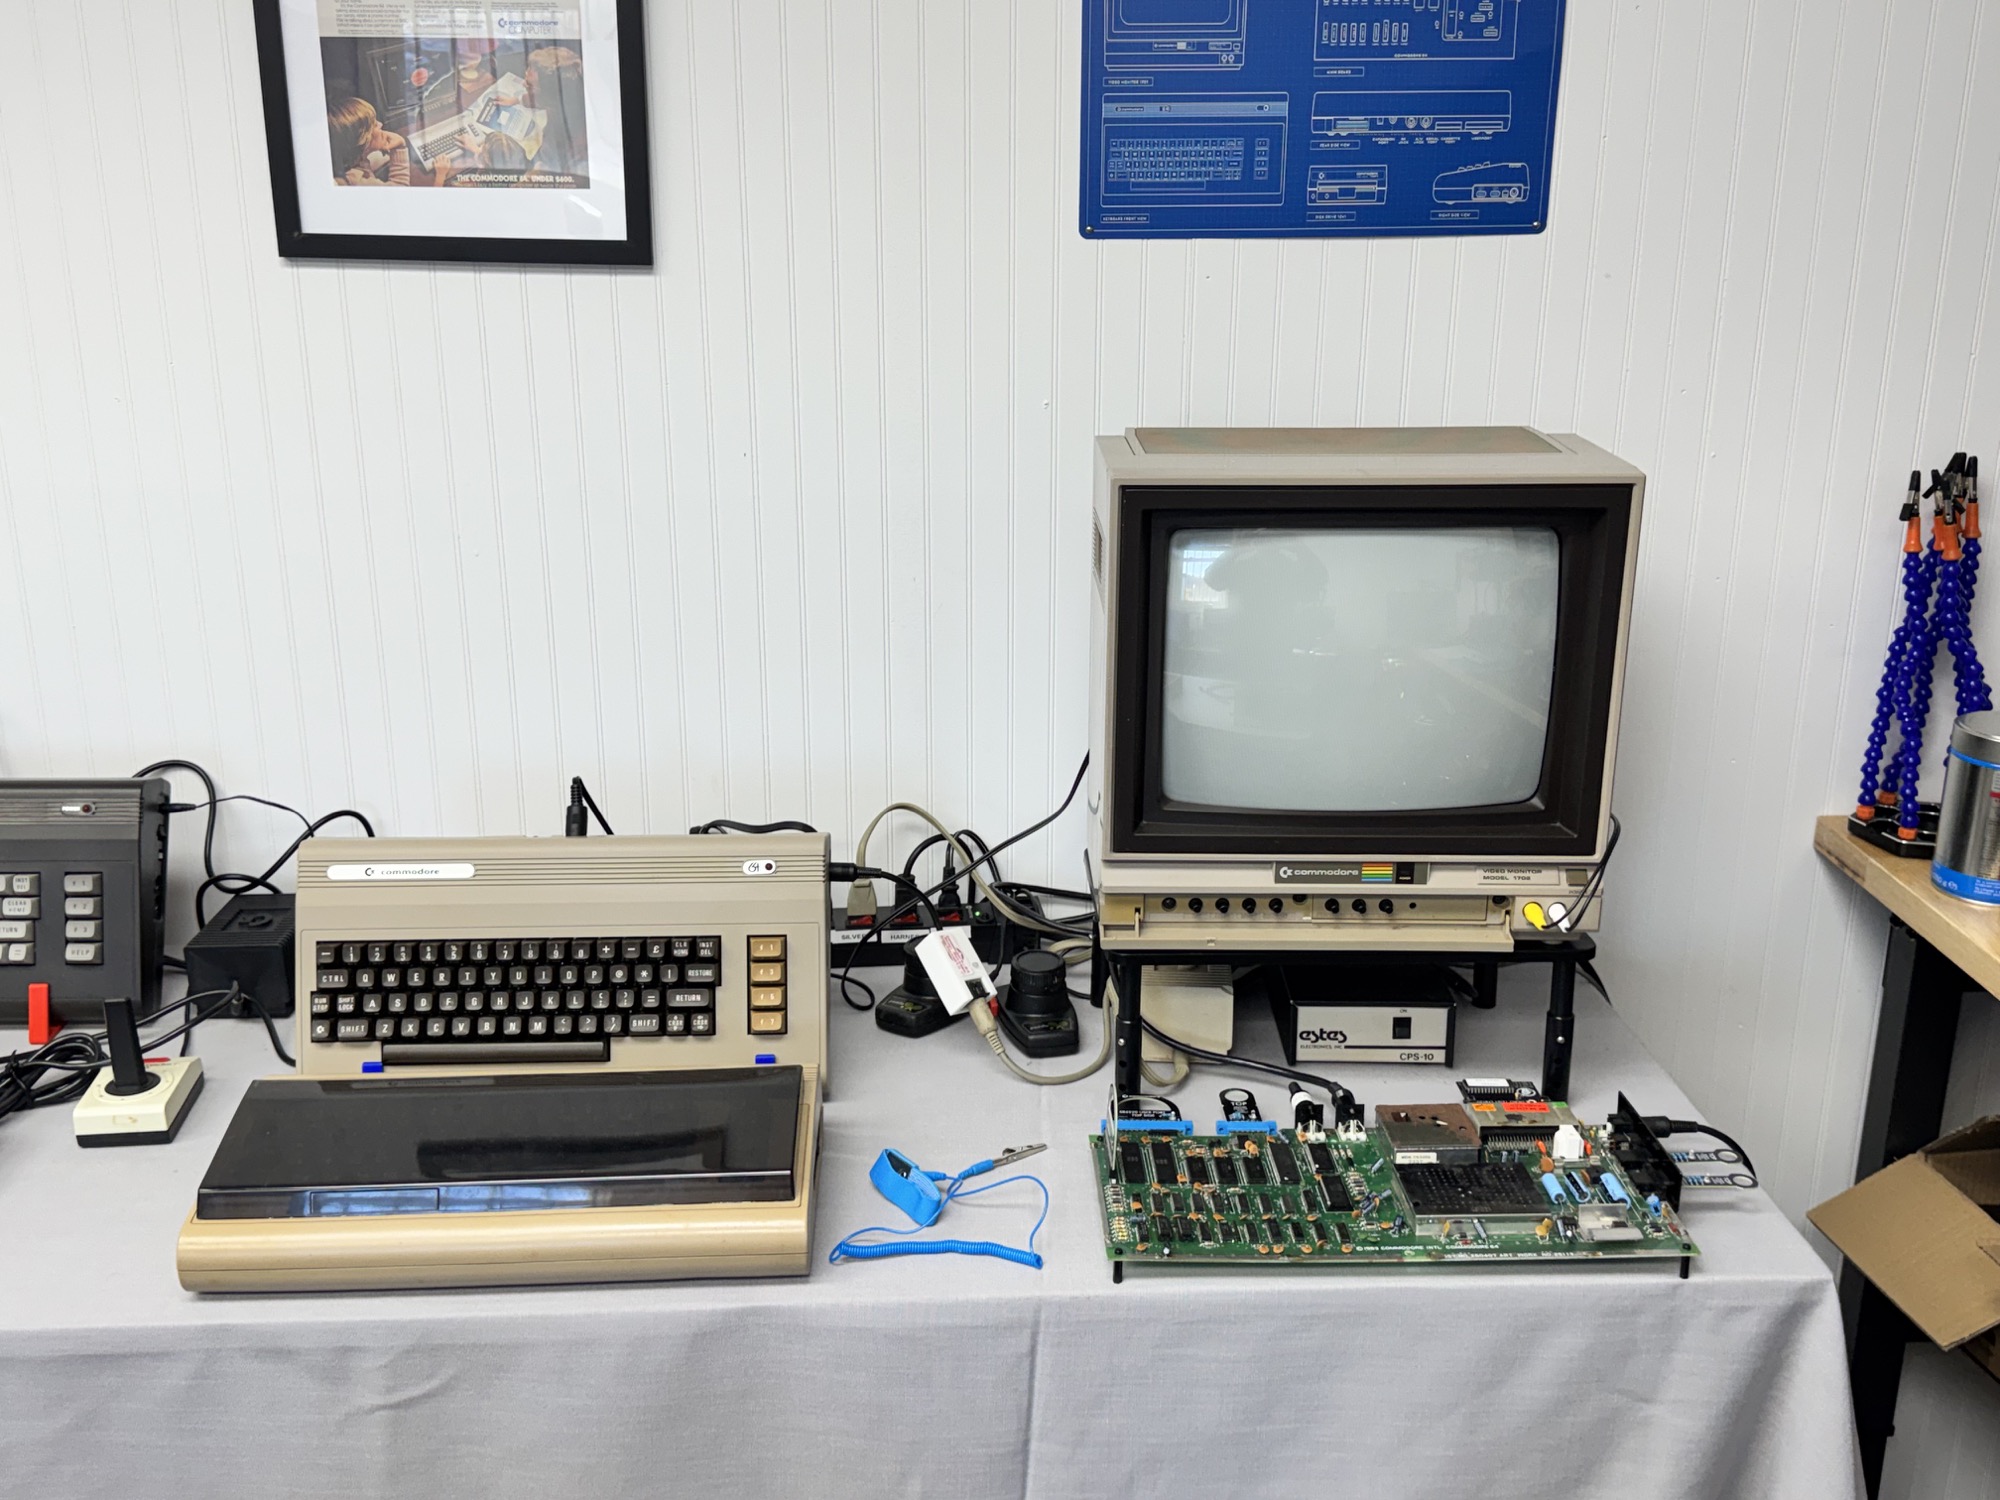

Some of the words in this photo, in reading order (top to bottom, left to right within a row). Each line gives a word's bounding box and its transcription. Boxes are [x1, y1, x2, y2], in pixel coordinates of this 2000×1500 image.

[387, 973, 396, 982] W
[615, 970, 623, 978] @
[534, 1022, 542, 1030] M
[1299, 1028, 1347, 1043] estes
[1400, 1053, 1434, 1061] CPS-10
